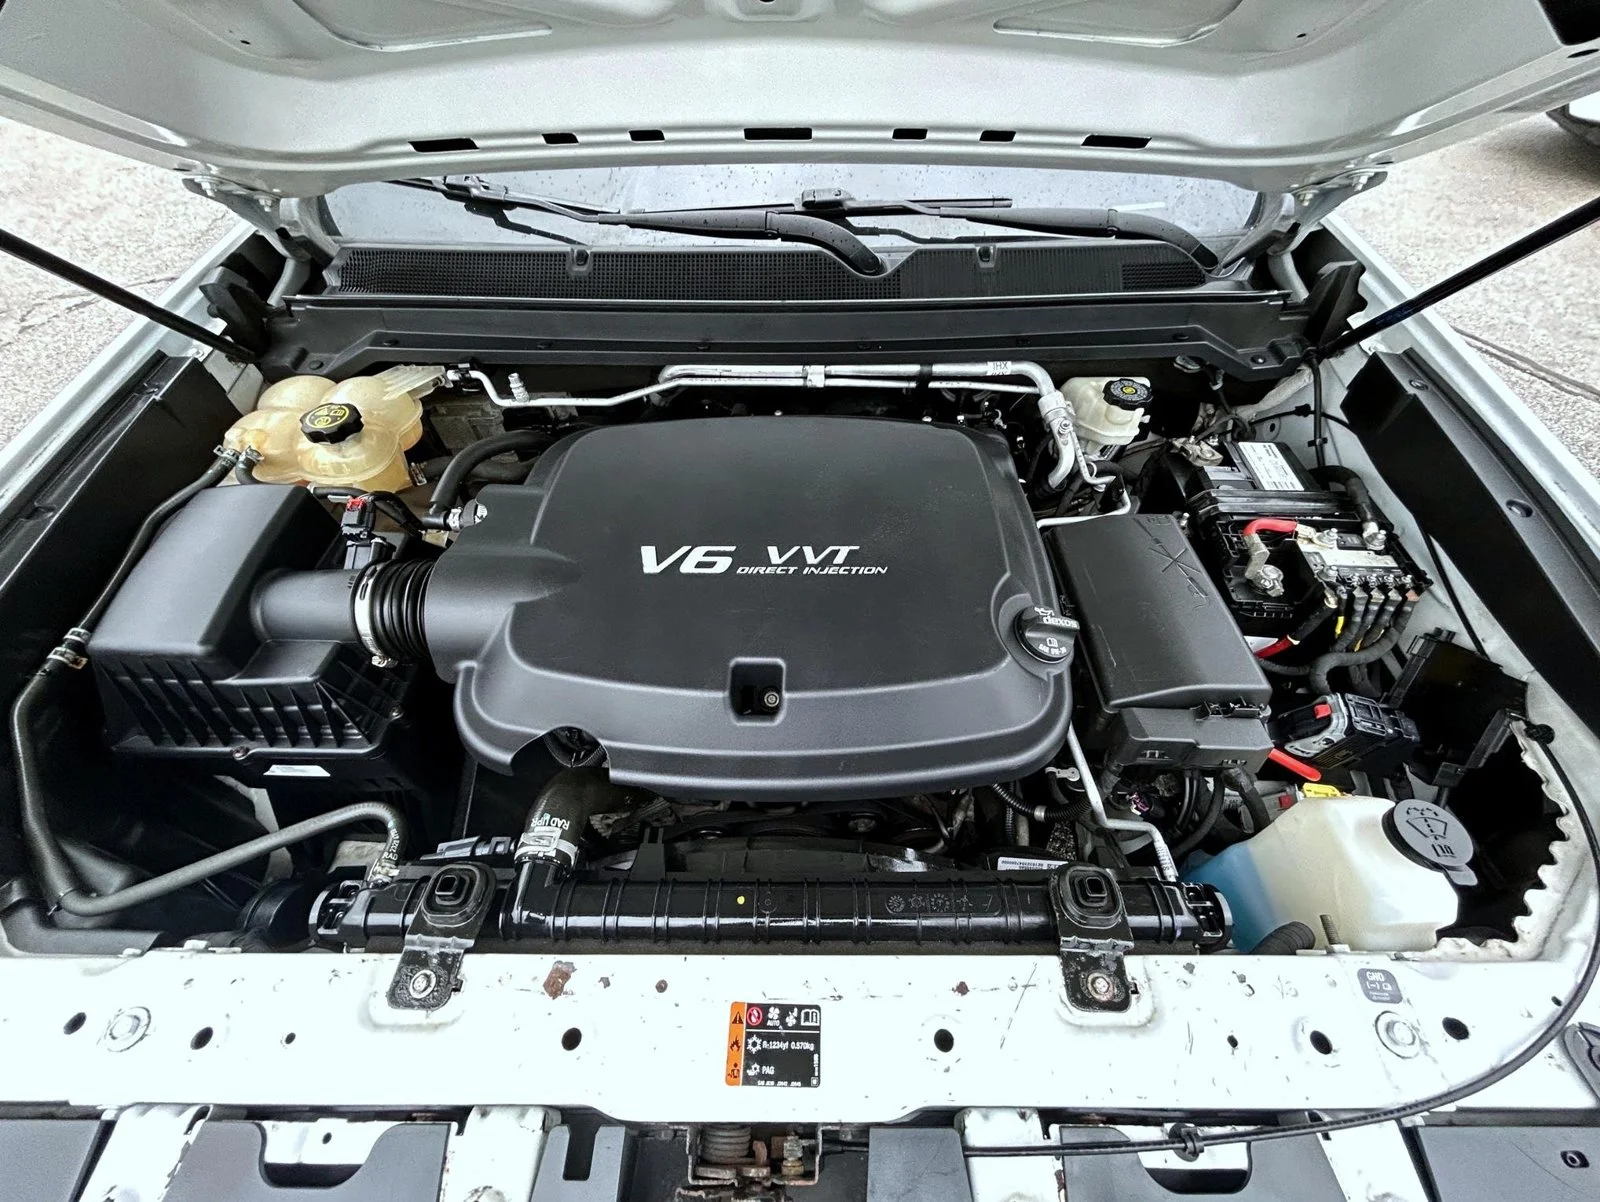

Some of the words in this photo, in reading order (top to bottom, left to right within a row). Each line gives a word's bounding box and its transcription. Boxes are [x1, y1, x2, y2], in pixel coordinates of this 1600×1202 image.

[641, 545, 737, 574] V6
[767, 545, 860, 565] VVT
[736, 566, 798, 575] DIRECT
[802, 566, 888, 575] INJECTION
[1042, 615, 1078, 628] dexos
[550, 817, 570, 830] RAD
[1366, 971, 1385, 981] GND
[761, 1066, 775, 1075] PAG
